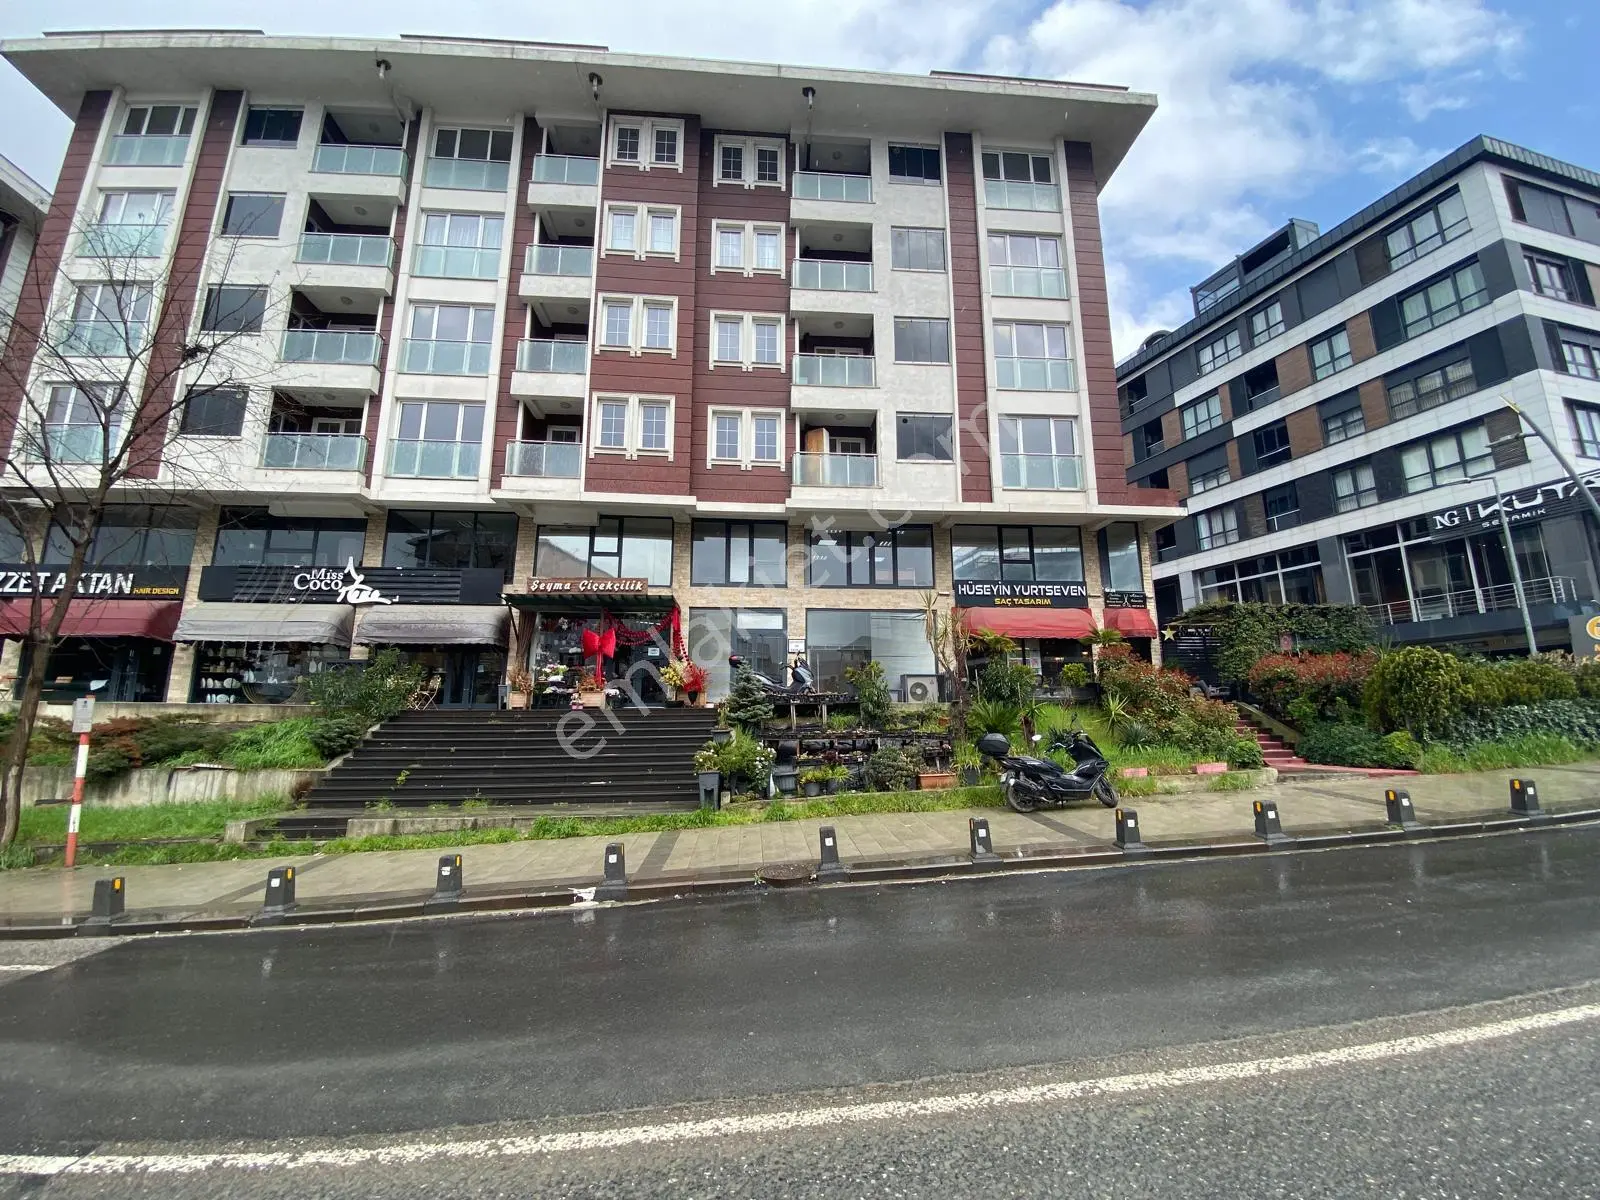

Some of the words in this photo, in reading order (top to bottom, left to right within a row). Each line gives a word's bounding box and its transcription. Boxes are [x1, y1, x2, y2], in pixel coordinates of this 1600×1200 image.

[1432, 510, 1461, 530] NG
[1481, 508, 1547, 528] SEAMIK
[310, 568, 344, 580] Miss
[152, 587, 180, 595] DESIGN
[530, 579, 571, 593] Şeyma
[578, 579, 643, 593] Çiçekçilik
[958, 581, 1011, 596] HÜSEYİN
[1013, 585, 1087, 596] YURTSEVEN
[994, 598, 1012, 607] SAÇ
[1013, 598, 1052, 606] TASARIM
